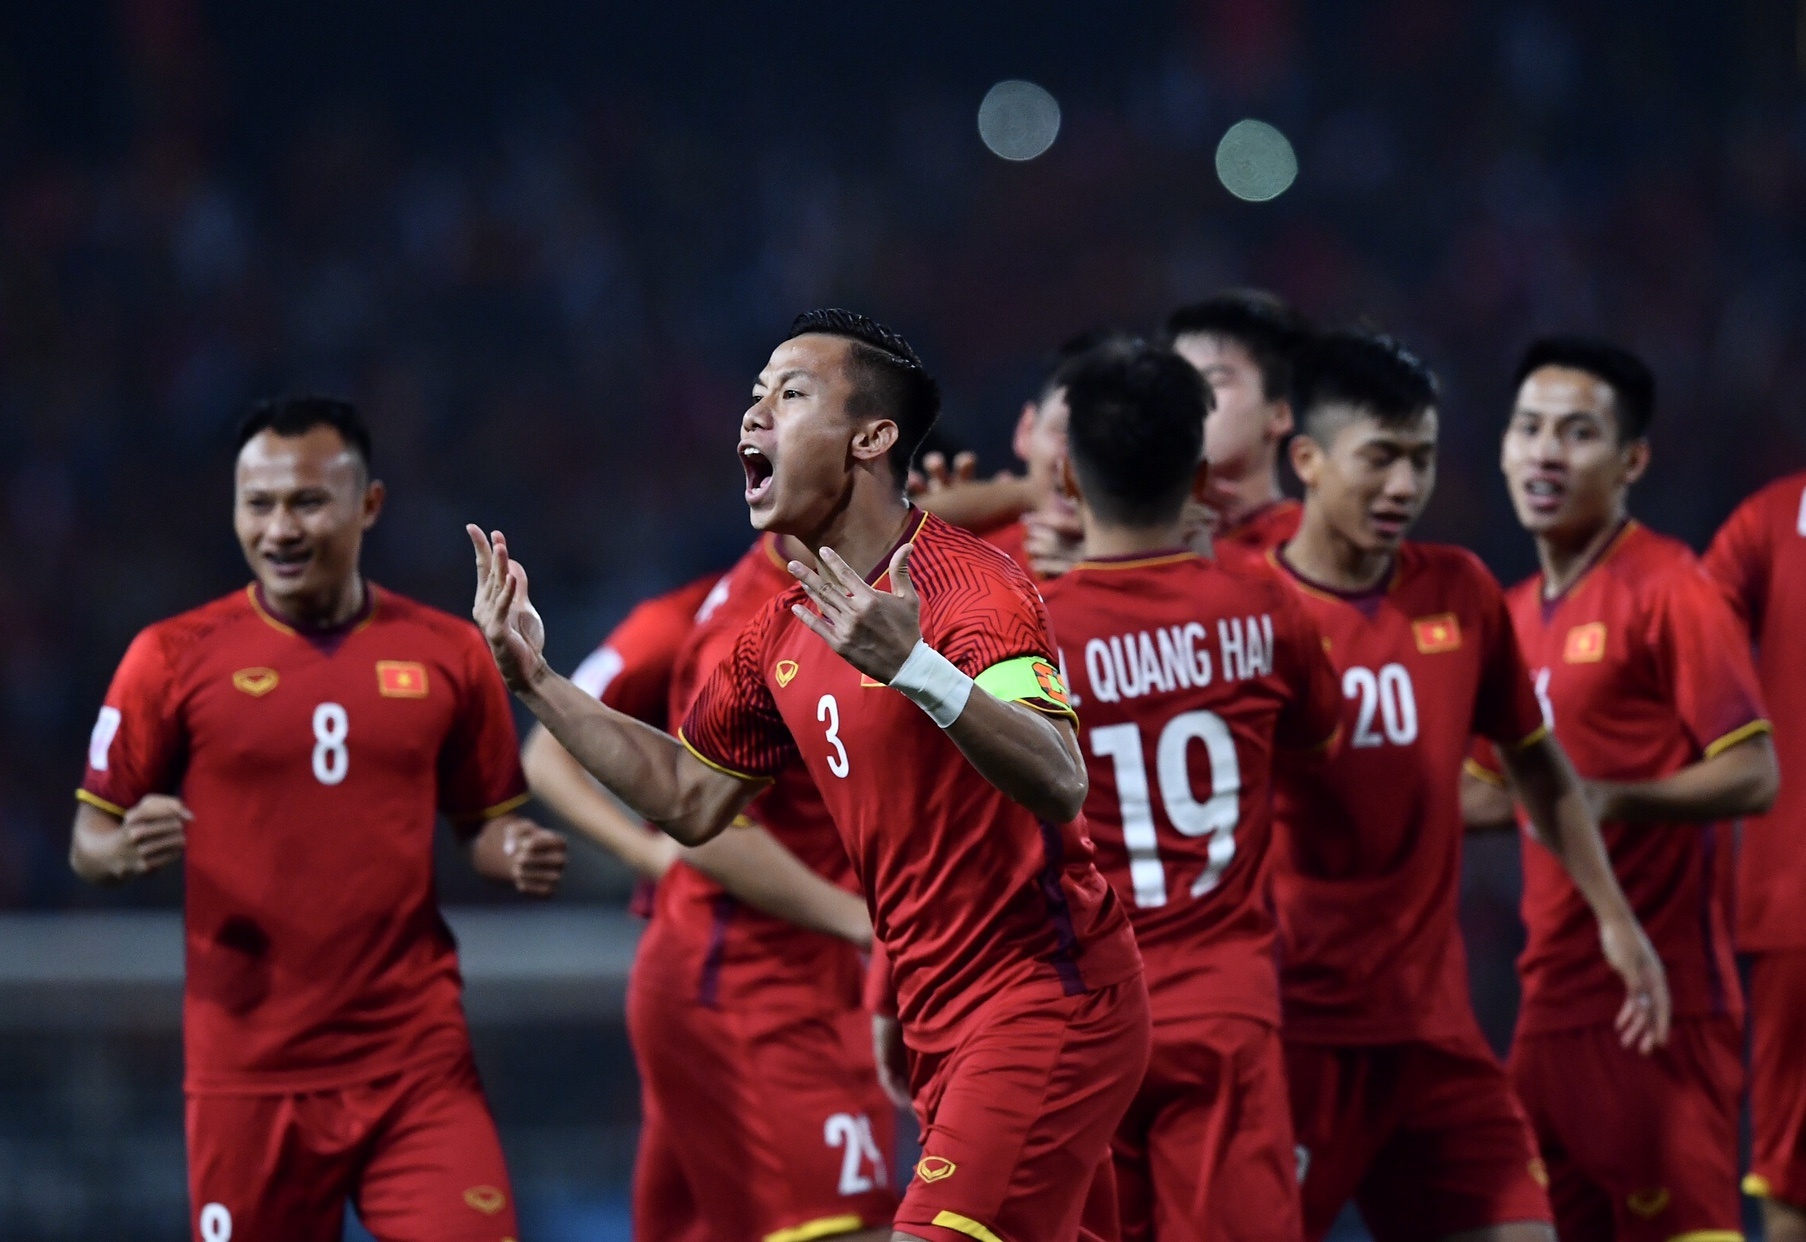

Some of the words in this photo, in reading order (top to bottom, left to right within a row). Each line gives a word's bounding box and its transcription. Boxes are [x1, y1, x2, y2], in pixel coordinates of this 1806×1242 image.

[1086, 622, 1212, 702] QUANG
[1218, 614, 1274, 682] HAI
[312, 702, 349, 785] 8
[816, 694, 850, 777] 3
[1342, 662, 1418, 748] 20
[1089, 709, 1240, 909] 19
